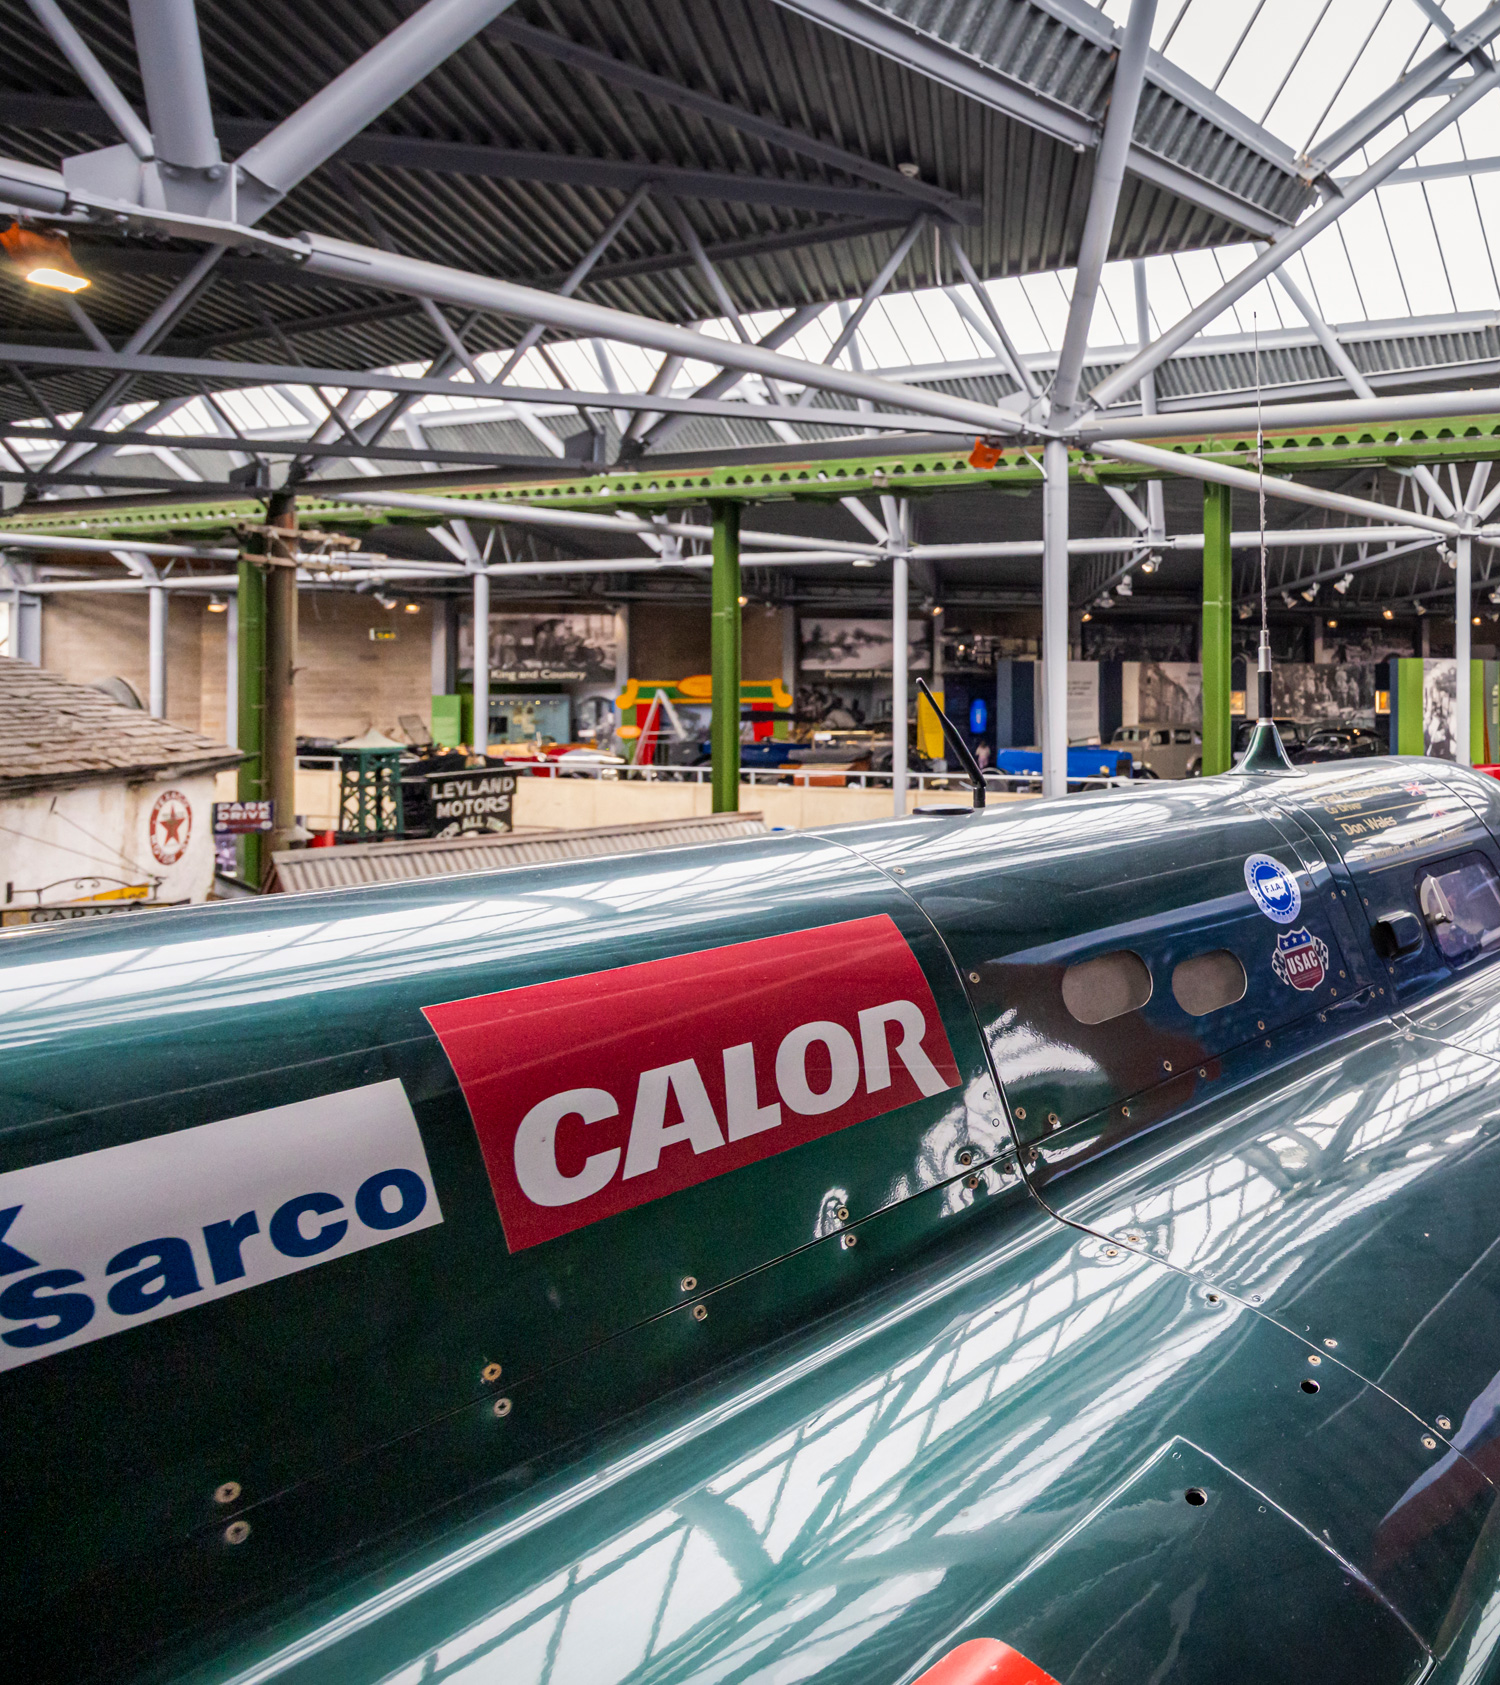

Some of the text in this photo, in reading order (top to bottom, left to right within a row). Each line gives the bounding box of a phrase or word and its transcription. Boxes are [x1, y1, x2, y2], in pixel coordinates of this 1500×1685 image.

[491, 669, 517, 681] King
[431, 776, 515, 800] LEYLAND
[217, 801, 271, 812] PARK
[217, 811, 271, 820] DRIVE
[436, 795, 510, 819] MOTORS
[1340, 816, 1398, 836] Don Wales
[1264, 883, 1283, 894] F.I.A.
[1286, 950, 1318, 975] USAC
[513, 1000, 951, 1207] CALOR
[0, 1168, 428, 1348] sarco
